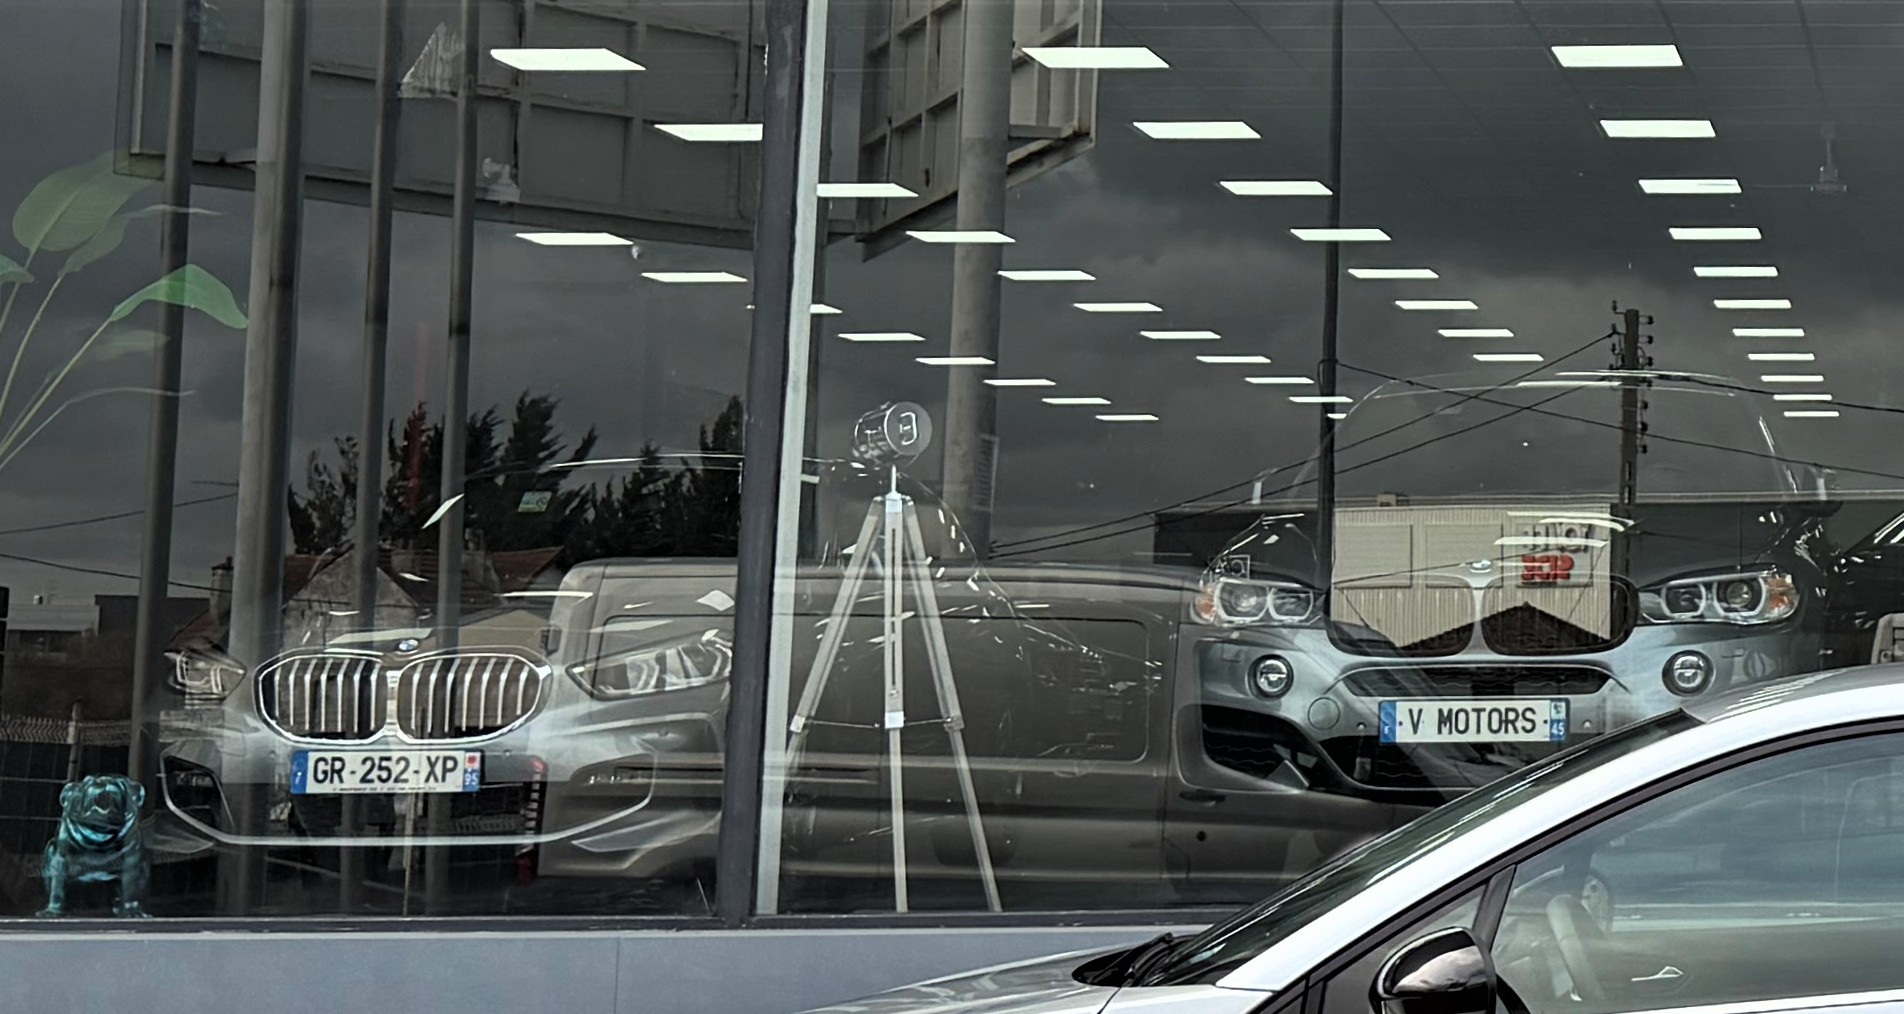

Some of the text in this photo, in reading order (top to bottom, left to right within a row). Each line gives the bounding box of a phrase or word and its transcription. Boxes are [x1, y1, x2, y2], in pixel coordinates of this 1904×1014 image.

[1407, 706, 1537, 736] V MOTORS
[1550, 722, 1566, 736] 45
[312, 755, 459, 785] GR-252-XP
